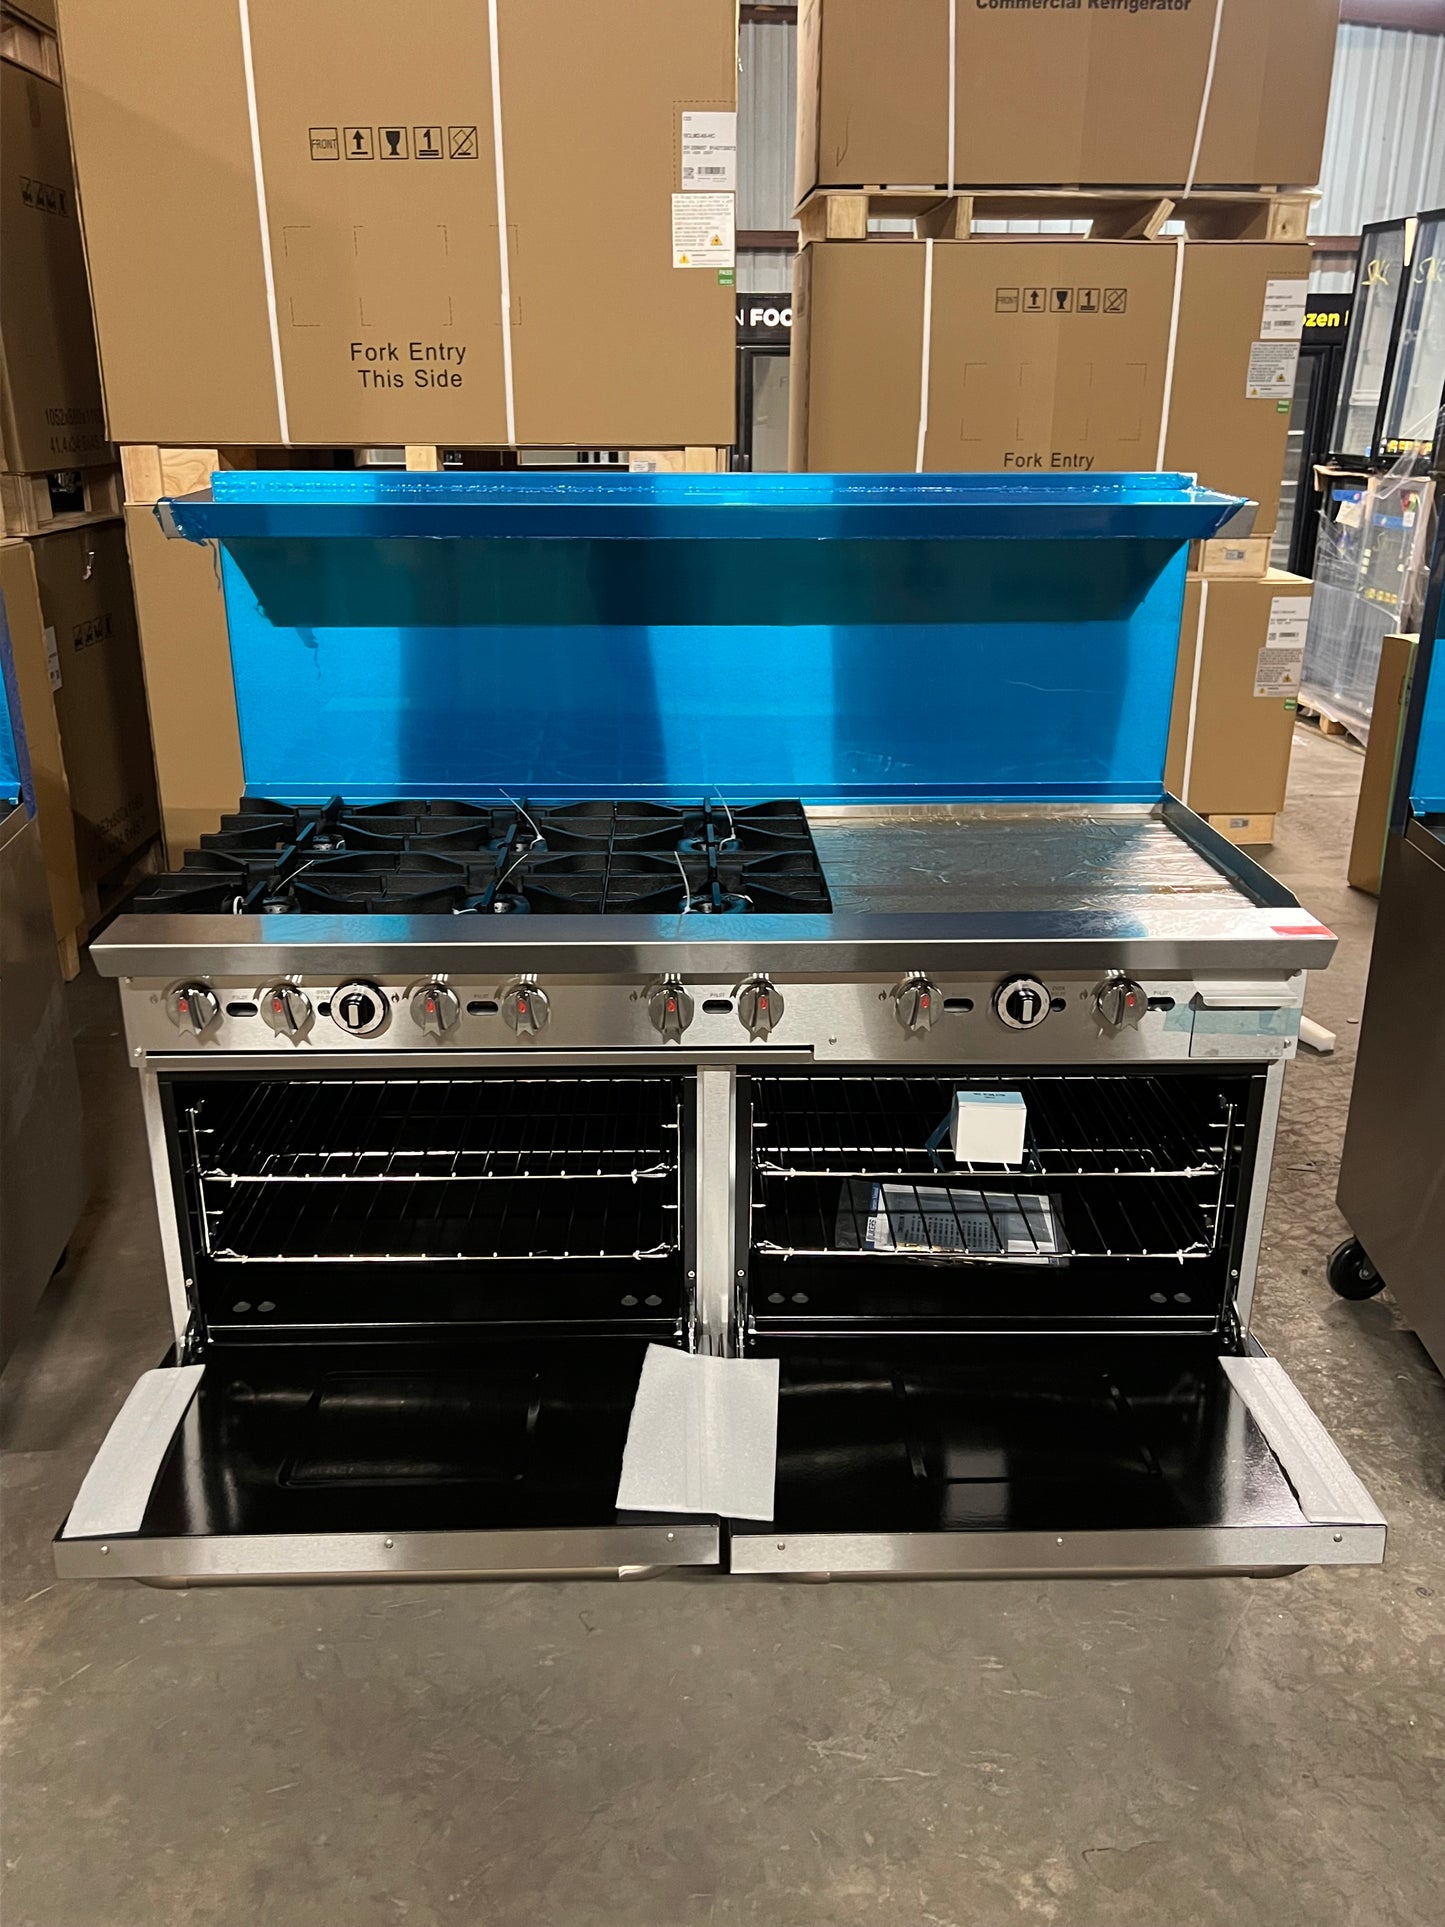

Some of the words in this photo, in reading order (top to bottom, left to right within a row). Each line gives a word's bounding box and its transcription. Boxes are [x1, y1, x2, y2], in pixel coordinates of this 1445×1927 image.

[976, 0, 1081, 9] Commercial
[1087, 0, 1191, 13] Refrigerator
[312, 138, 337, 149] FRONT
[350, 342, 399, 361] Fork
[409, 342, 466, 365] Entry
[357, 369, 404, 388] This
[414, 369, 462, 388] Side
[1003, 452, 1042, 468] Fork
[1051, 452, 1095, 471] Entry
